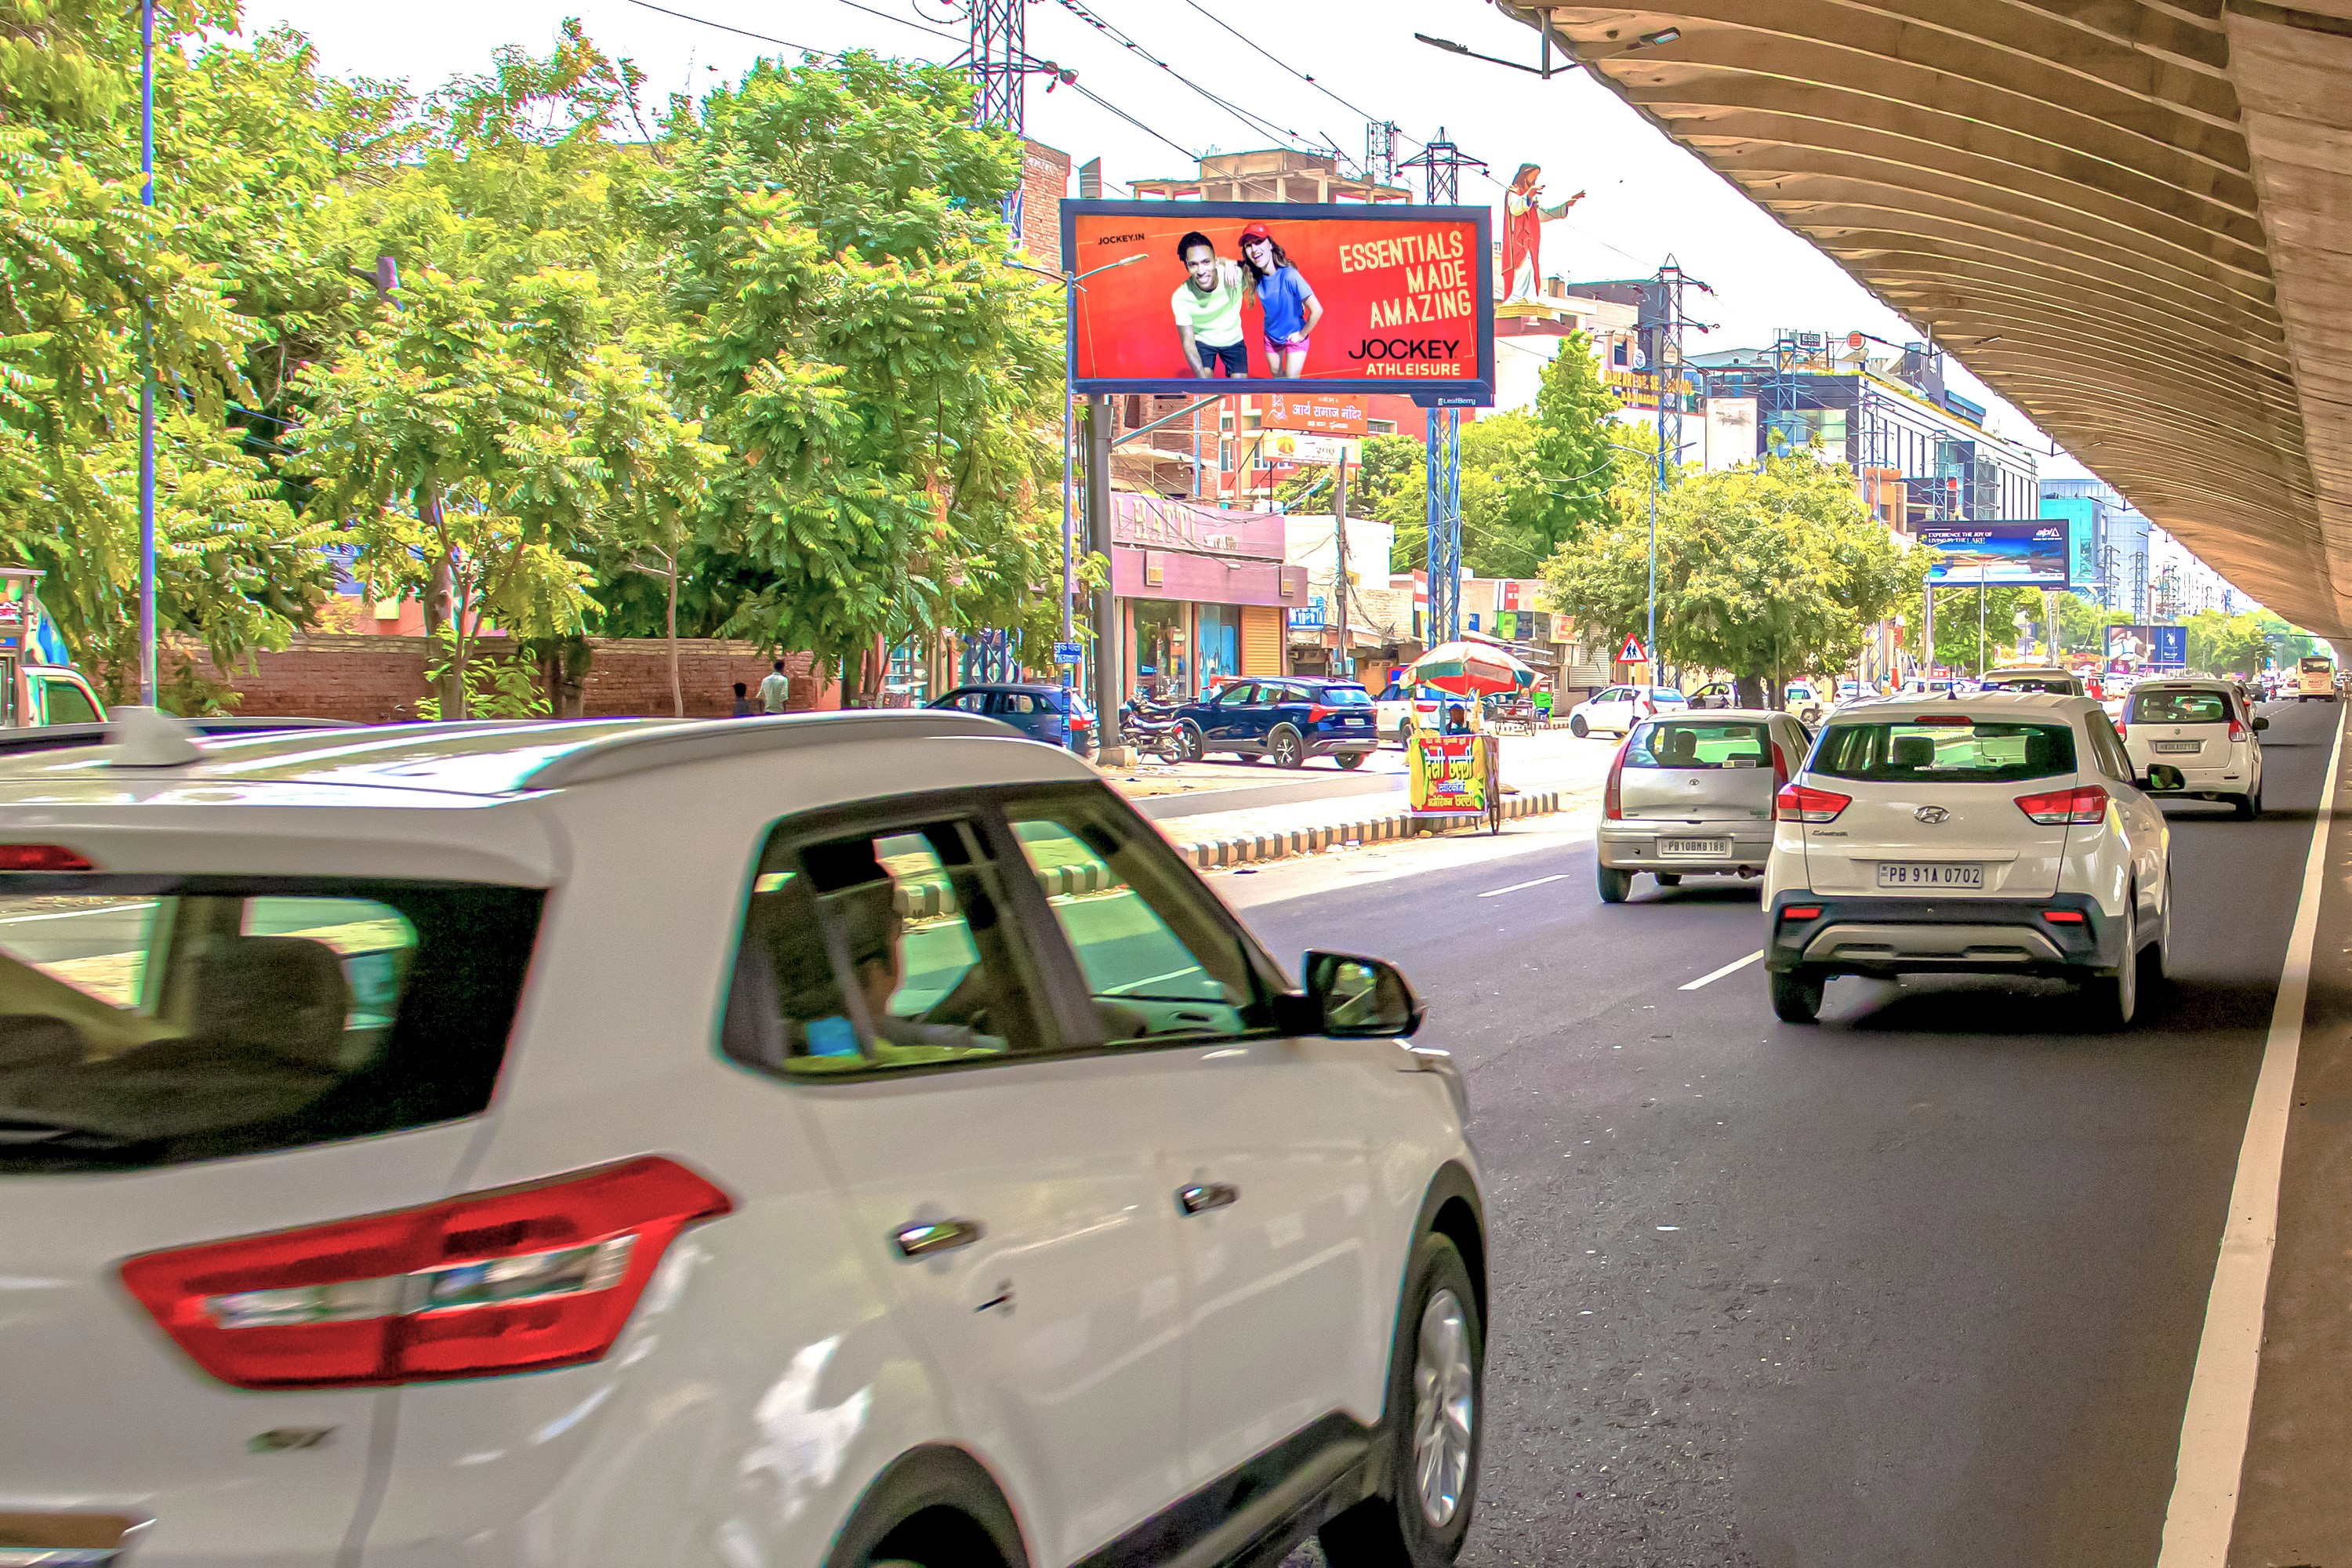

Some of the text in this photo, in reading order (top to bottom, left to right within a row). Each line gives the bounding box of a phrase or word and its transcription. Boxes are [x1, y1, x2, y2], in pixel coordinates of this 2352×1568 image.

[1098, 233, 1145, 245] JOCKEY.IN
[1339, 230, 1464, 273] ESSENTIALS
[1406, 260, 1468, 294] MADE
[1370, 289, 1472, 329] AMAZING
[1348, 339, 1460, 359] JOCKEY
[1367, 363, 1461, 376] ATHLEISURE
[1292, 401, 1362, 420] आर्य समाज मंदिर
[1889, 867, 1980, 884] PB 91A 0702
